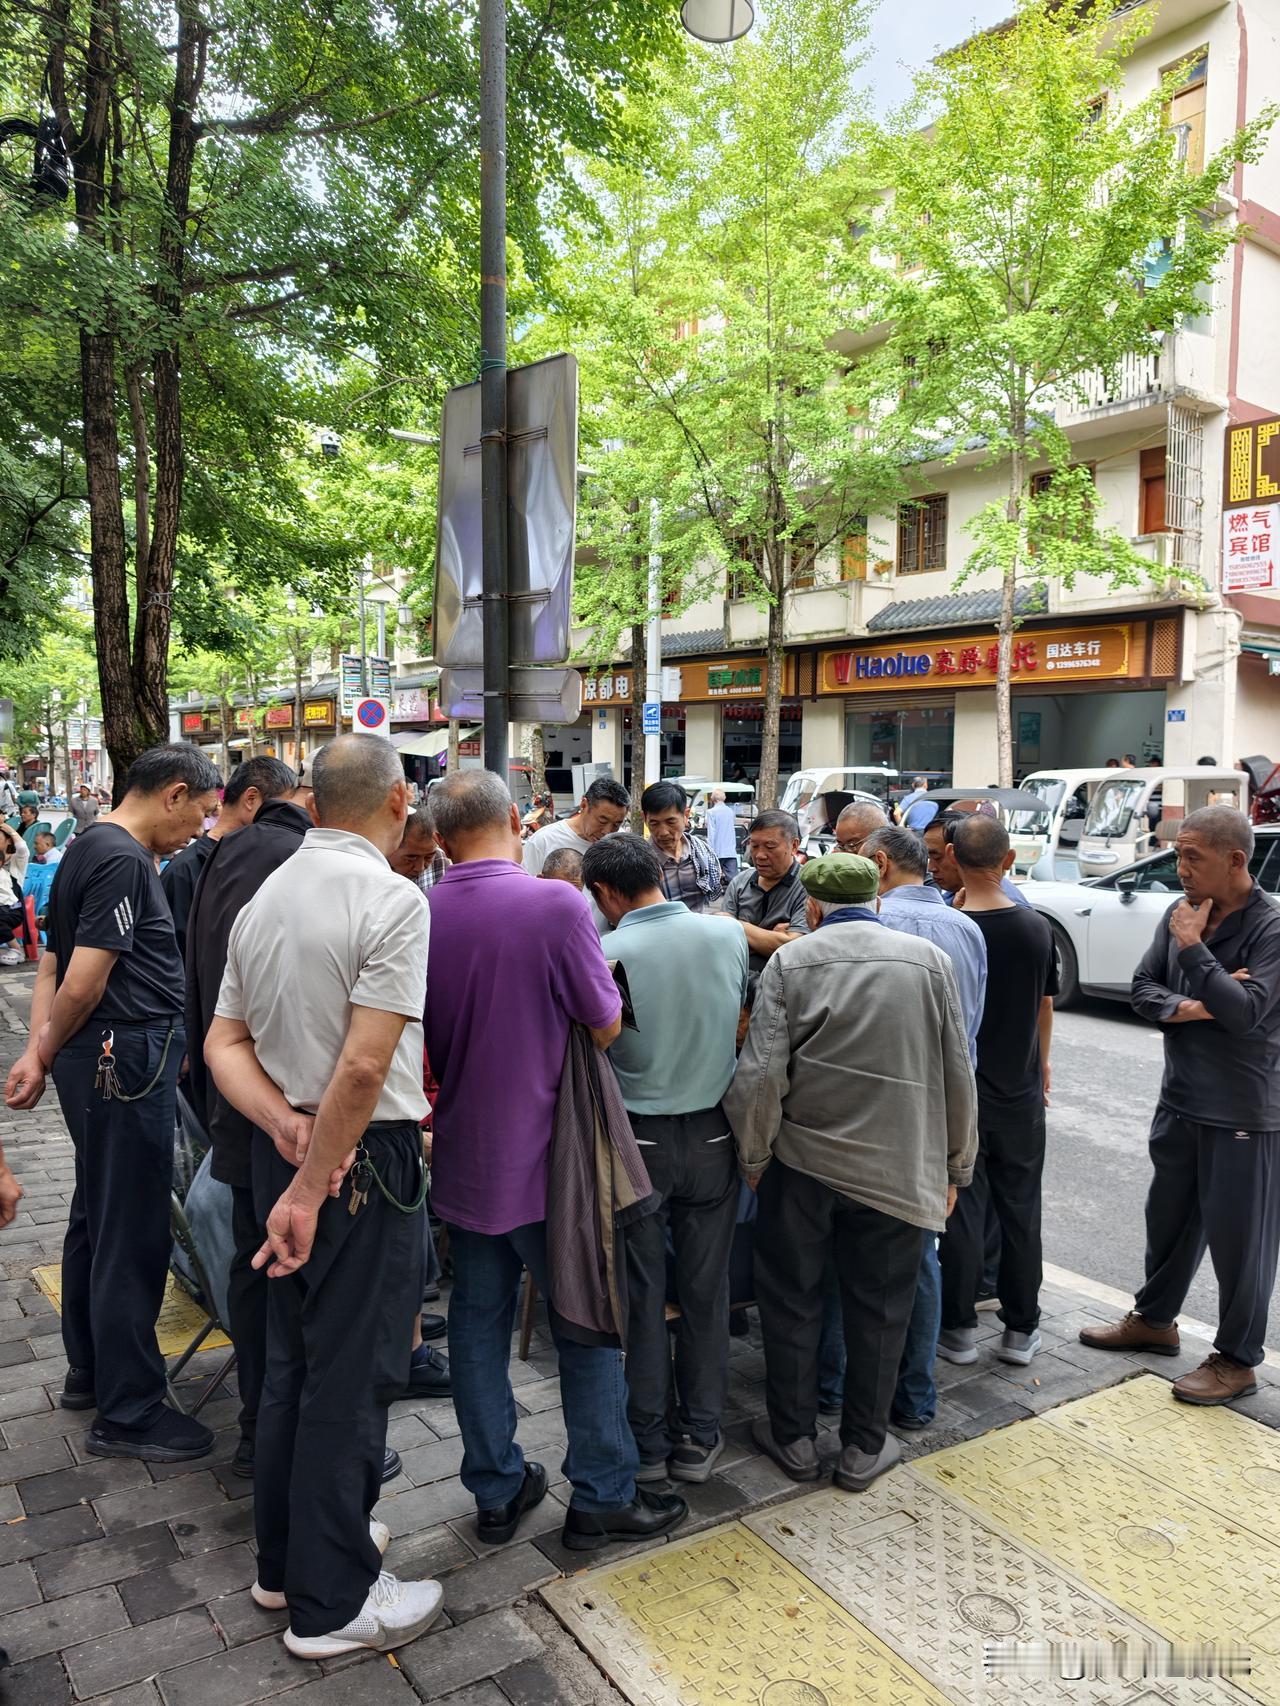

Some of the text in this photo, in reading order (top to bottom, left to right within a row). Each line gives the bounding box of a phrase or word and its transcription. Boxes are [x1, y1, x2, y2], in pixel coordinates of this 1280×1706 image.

[1229, 511, 1271, 533] 燃气
[1229, 533, 1271, 556] 宾馆
[1046, 640, 1101, 658] 国达车行
[856, 652, 932, 679] Haojue
